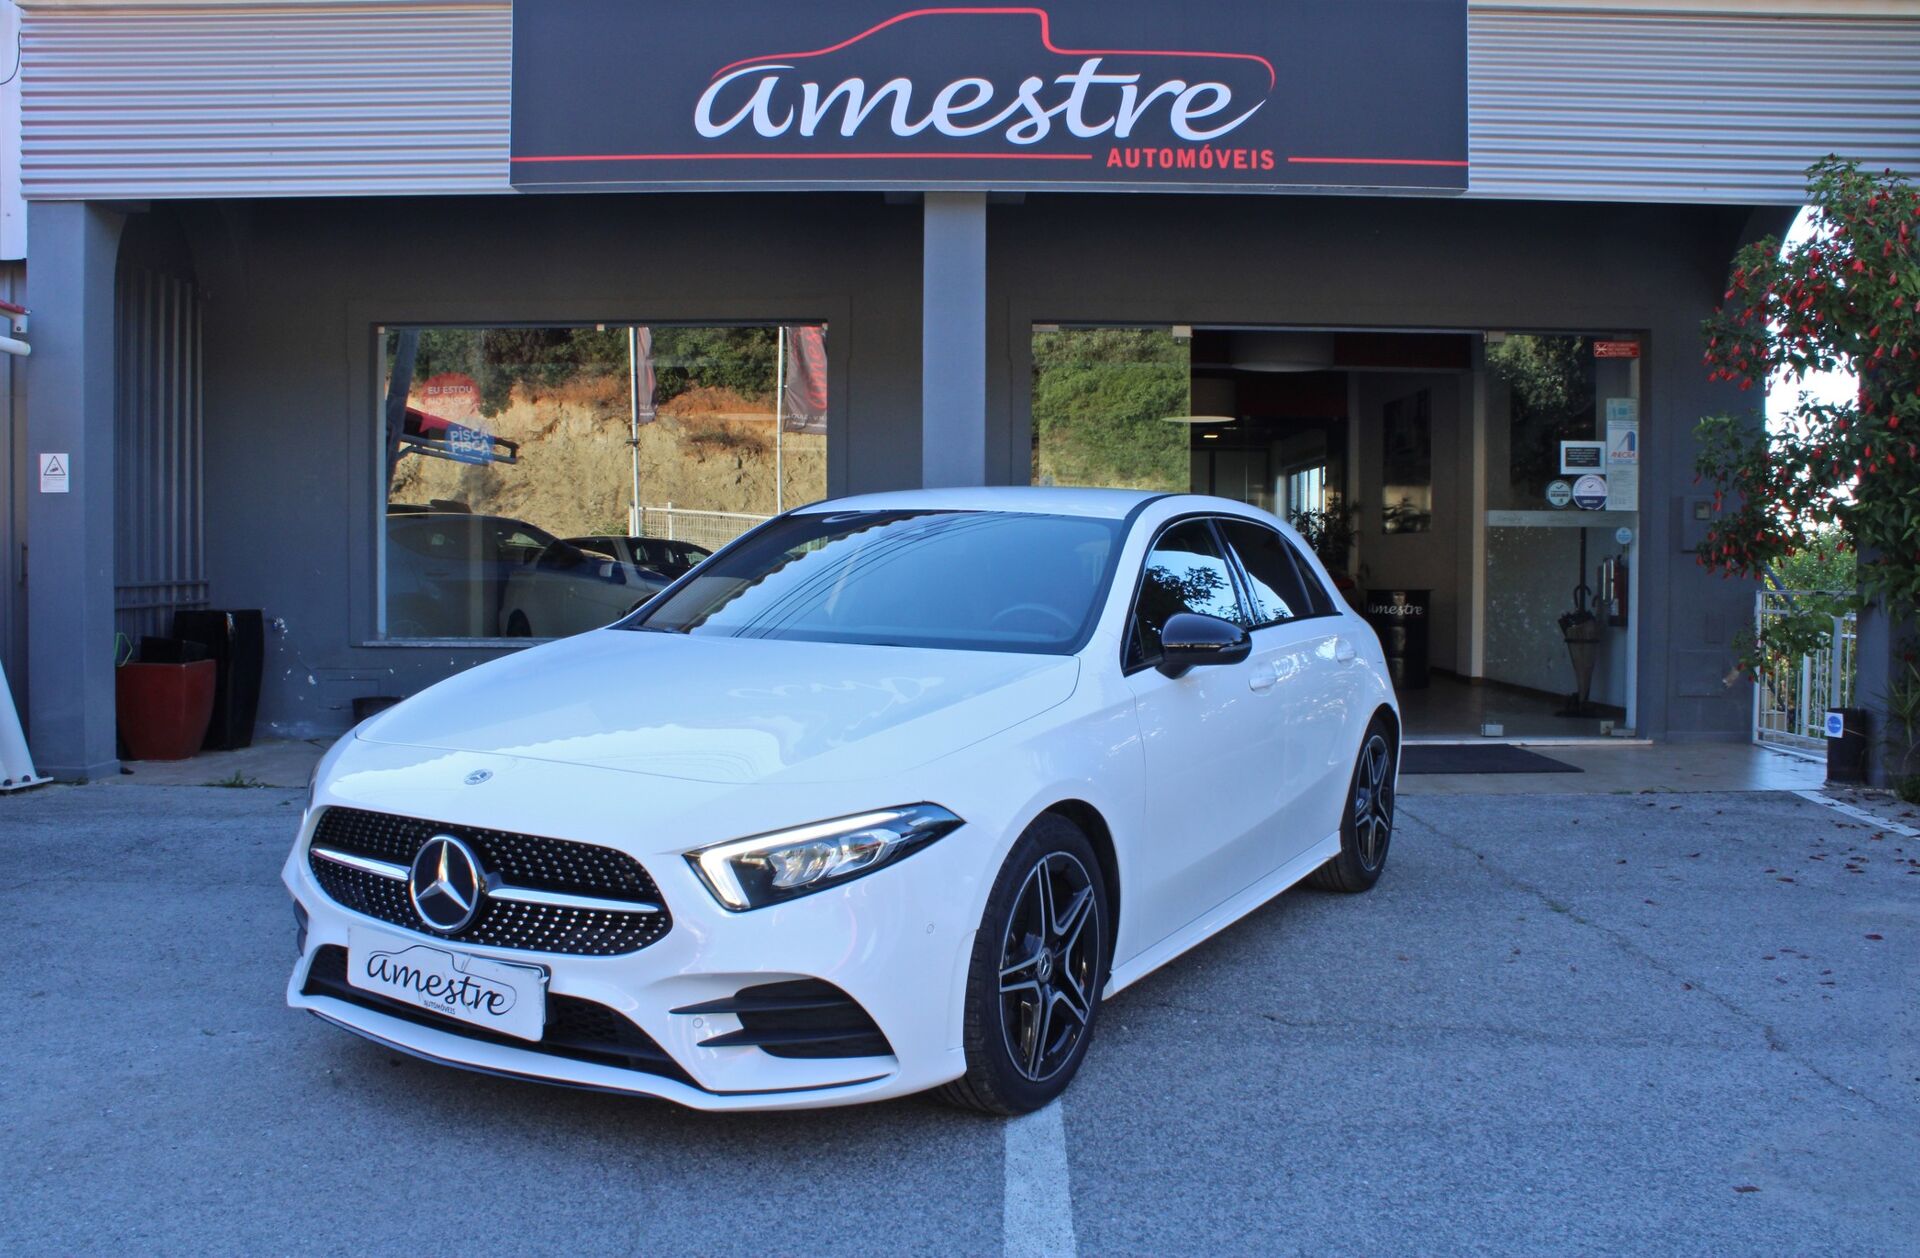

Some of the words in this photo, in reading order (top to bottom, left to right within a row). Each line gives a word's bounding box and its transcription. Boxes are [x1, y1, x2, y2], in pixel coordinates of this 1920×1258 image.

[694, 57, 1267, 145] amestre
[1106, 144, 1276, 170] AUTOMÓVEIS
[427, 386, 440, 395] EU
[442, 385, 473, 394] ESTOU
[367, 954, 516, 1015] amestre
